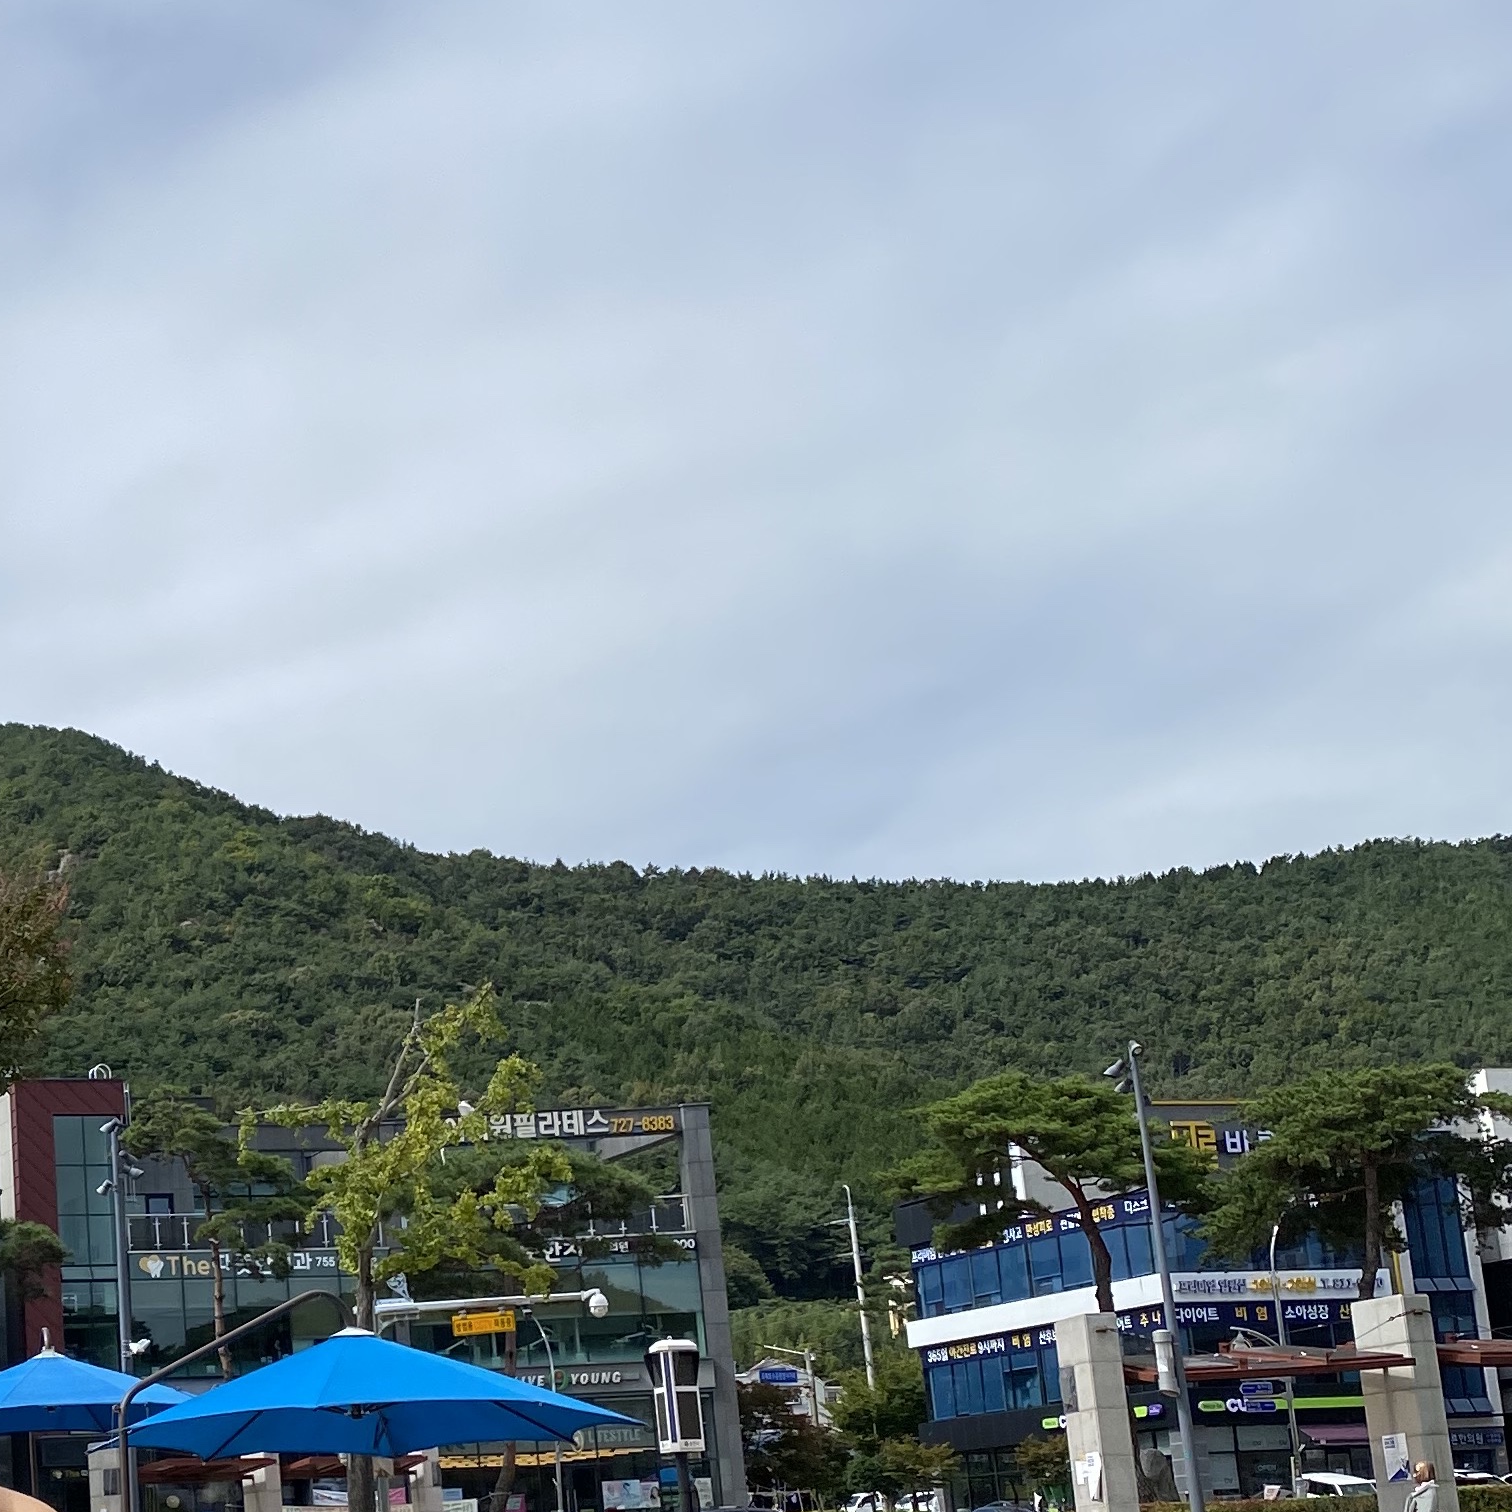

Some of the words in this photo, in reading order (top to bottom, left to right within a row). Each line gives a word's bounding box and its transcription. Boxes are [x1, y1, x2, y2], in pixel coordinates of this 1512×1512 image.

[610, 1115, 675, 1133] 727-8383
[1285, 1304, 1329, 1320] 소아성장
[978, 1337, 1005, 1355] 9시까지
[571, 1371, 622, 1385] YOUNG
